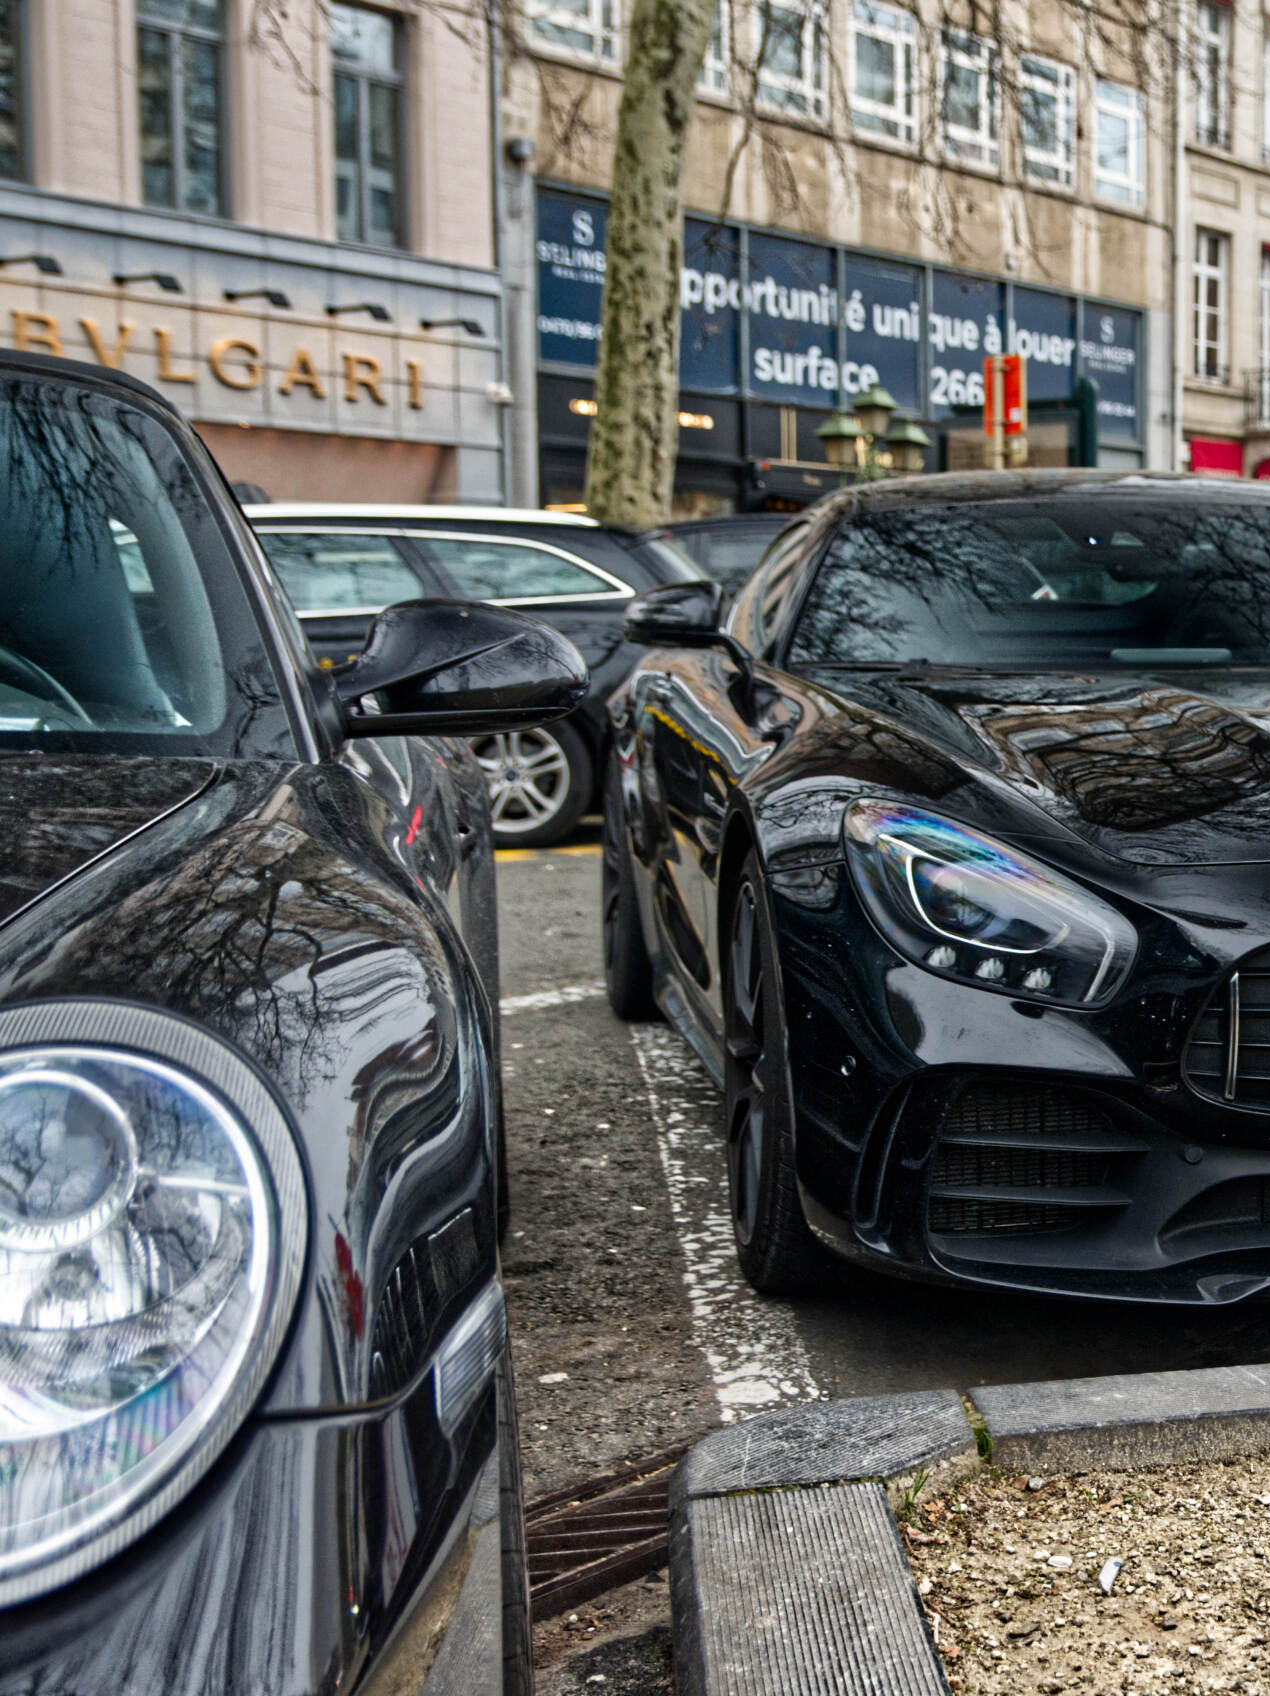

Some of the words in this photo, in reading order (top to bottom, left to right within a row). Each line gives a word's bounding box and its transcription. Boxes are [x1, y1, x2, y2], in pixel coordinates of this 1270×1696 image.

[536, 240, 607, 272] SELING
[572, 209, 594, 246] S
[679, 267, 866, 333] pportunité
[1008, 318, 1075, 367] louer
[11, 309, 423, 410] BVLGARI
[753, 345, 879, 393] surface
[929, 365, 985, 406] 266
